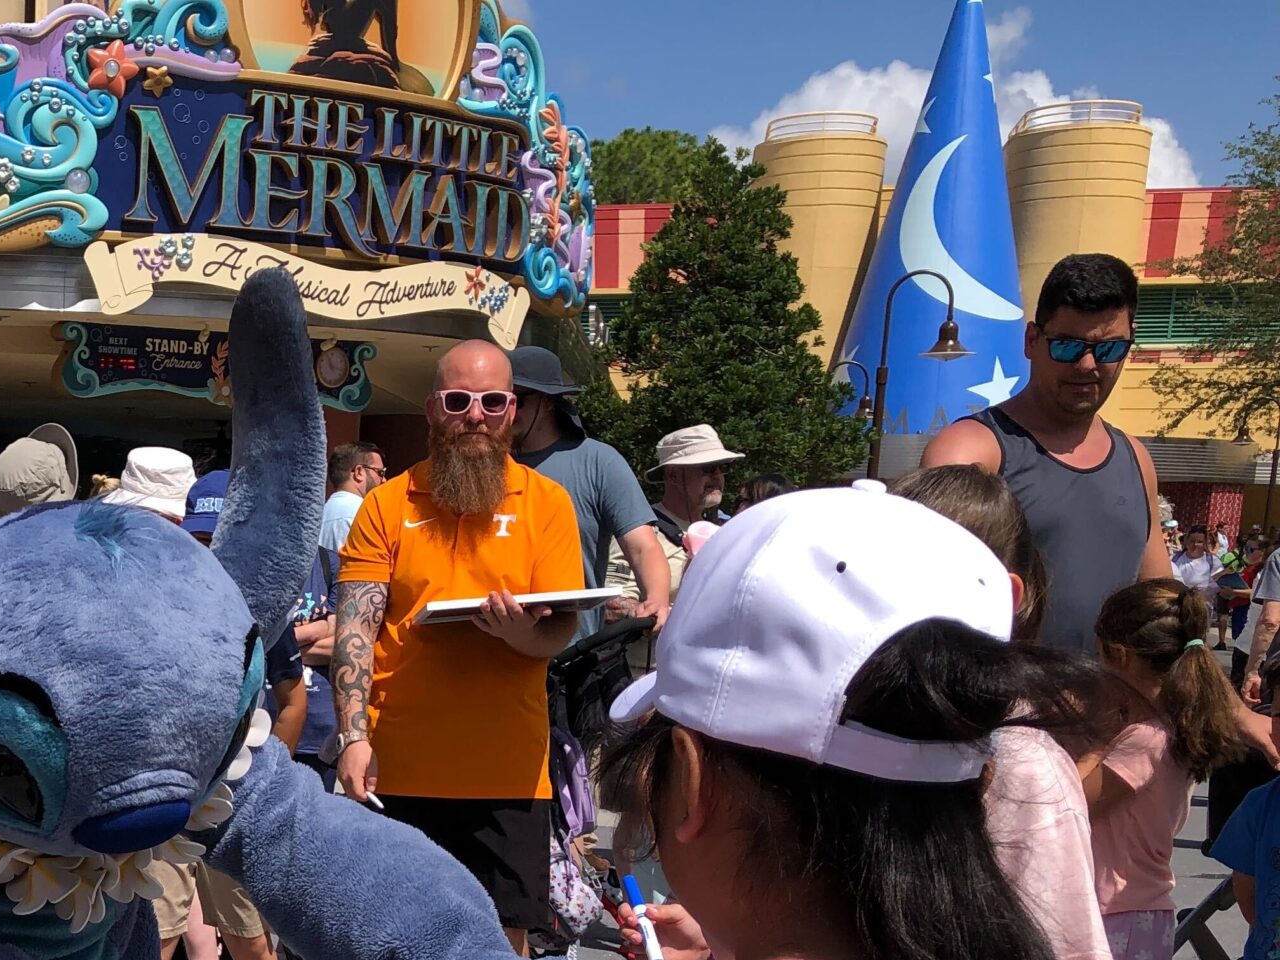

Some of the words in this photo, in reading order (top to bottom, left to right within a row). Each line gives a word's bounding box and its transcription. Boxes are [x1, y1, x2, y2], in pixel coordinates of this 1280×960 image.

[251, 89, 368, 153] THE
[372, 106, 522, 181] LITTLE
[123, 103, 532, 264] MERMAID
[202, 243, 247, 280] A
[356, 276, 457, 318] Adventure
[98, 345, 139, 356] SHOWTIME
[109, 336, 129, 346] NEXT
[145, 337, 210, 356] STAND-BY
[149, 353, 203, 372] Entrance
[492, 513, 517, 537] T
